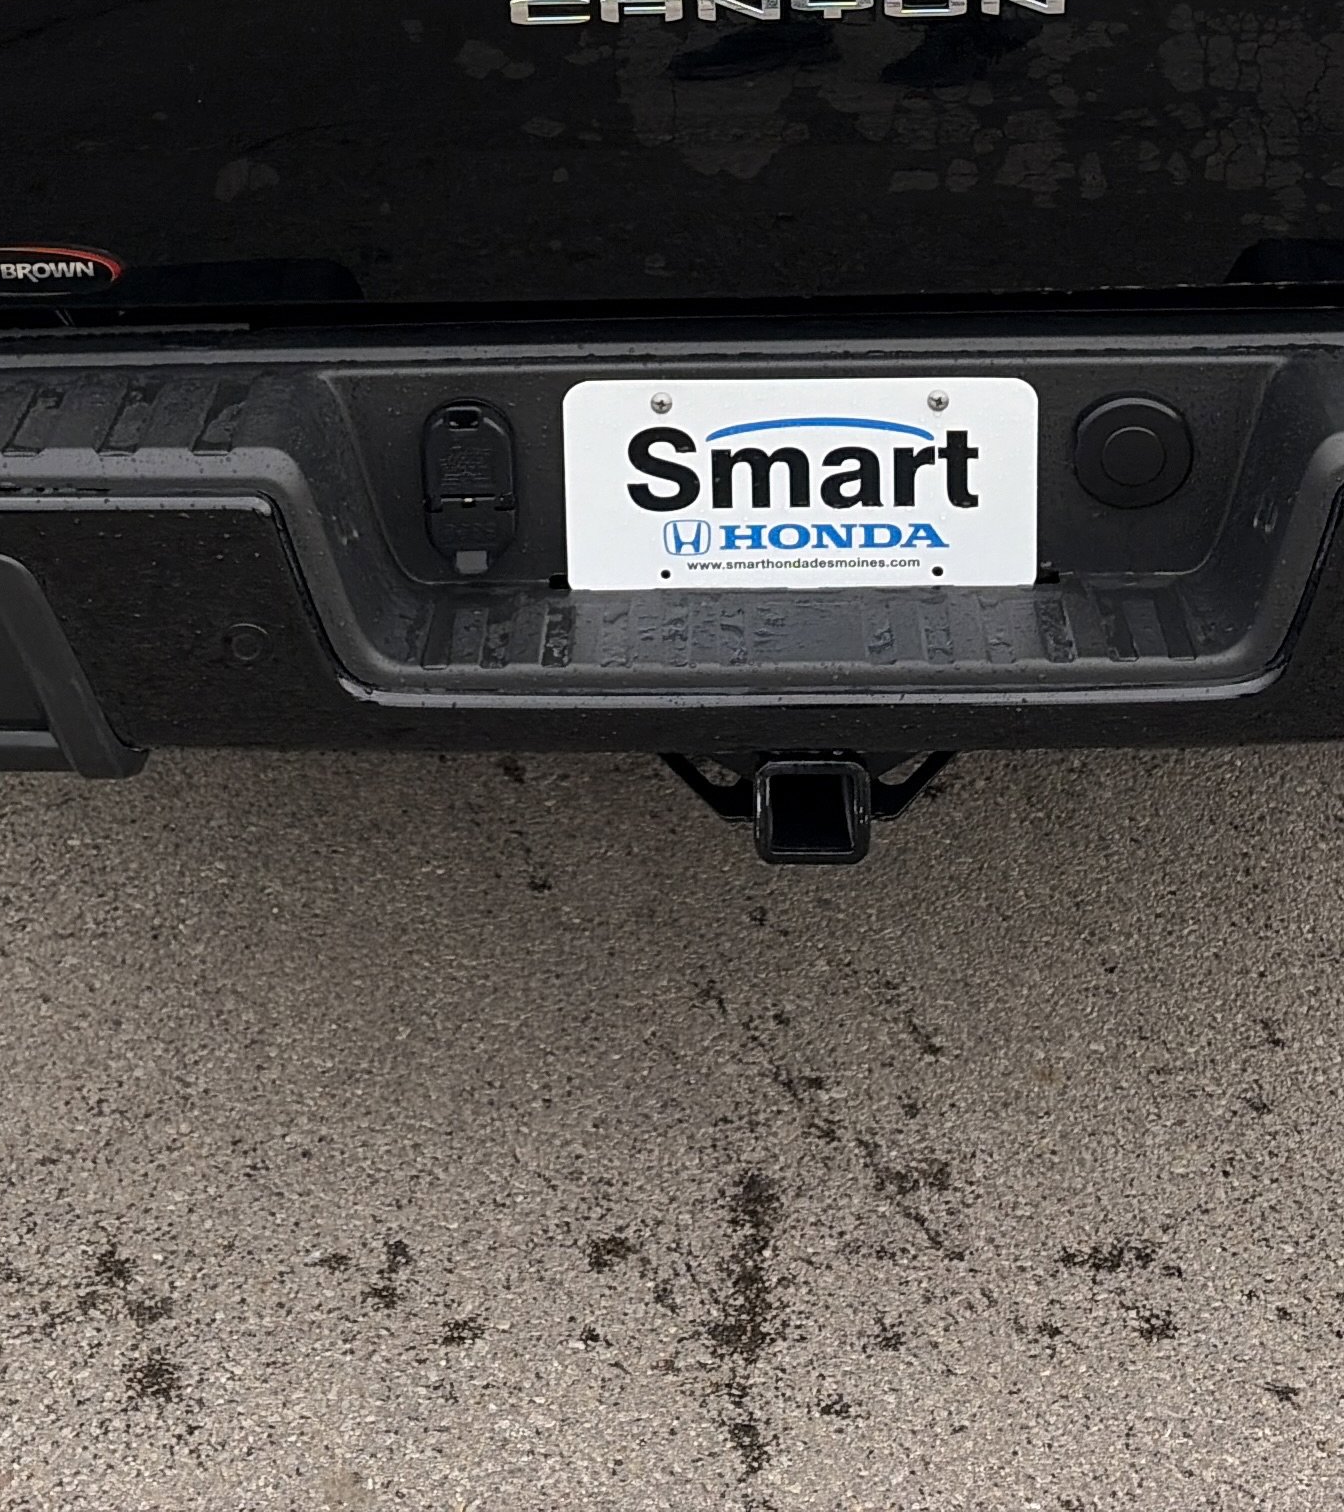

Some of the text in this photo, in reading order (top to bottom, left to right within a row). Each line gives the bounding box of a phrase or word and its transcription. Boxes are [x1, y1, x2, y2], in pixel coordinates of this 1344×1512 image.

[1, 262, 94, 282] BROWN
[627, 426, 979, 512] Smart
[720, 523, 949, 549] HONDA
[687, 555, 921, 571] www.smarthondadesmoines.com
